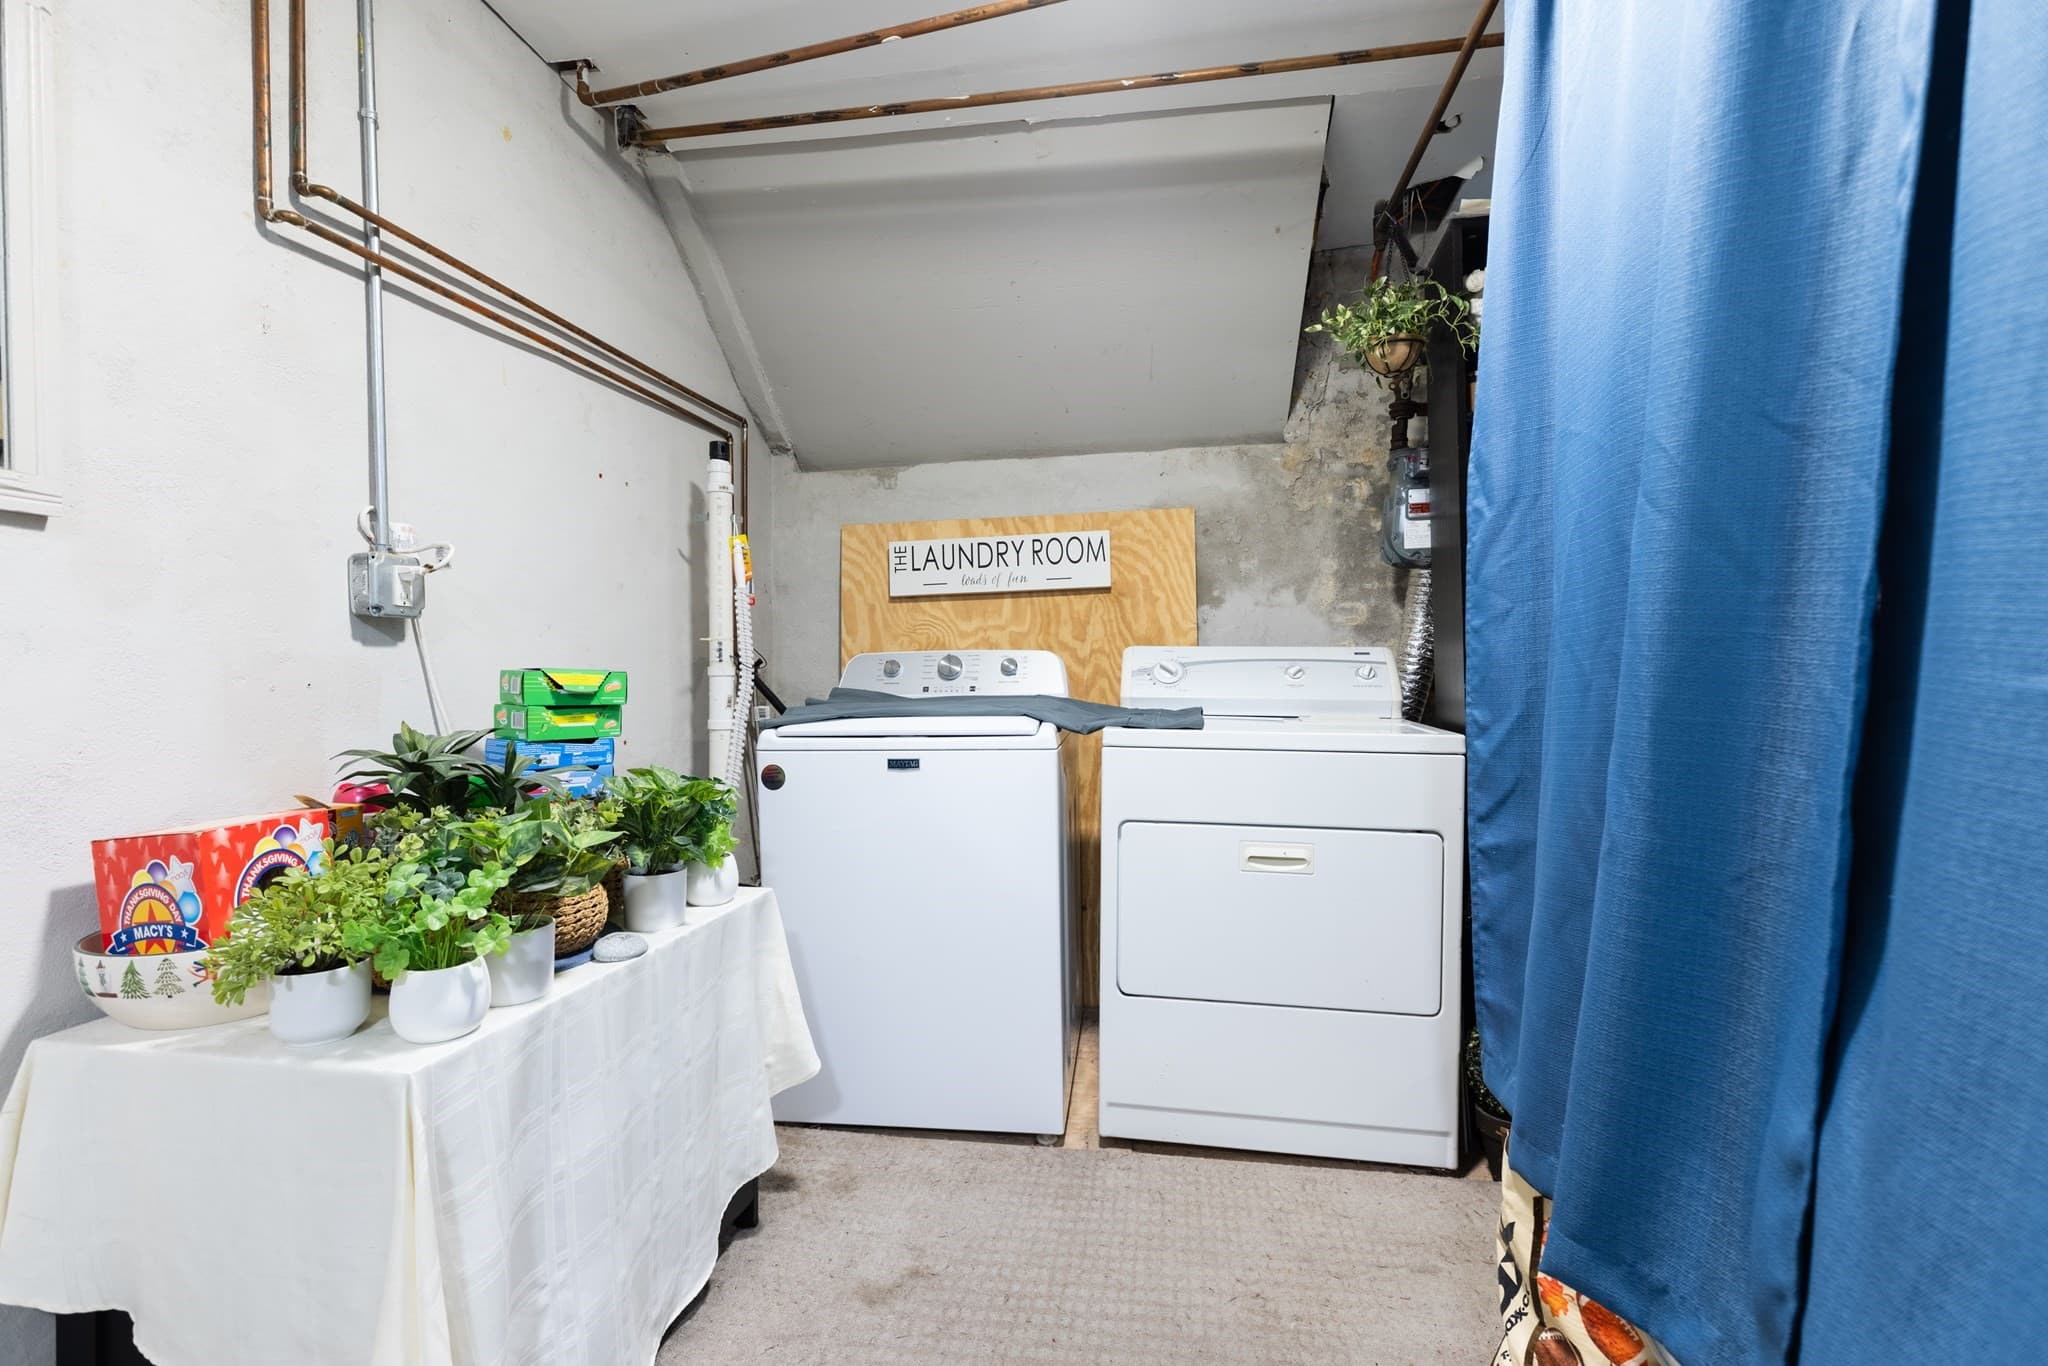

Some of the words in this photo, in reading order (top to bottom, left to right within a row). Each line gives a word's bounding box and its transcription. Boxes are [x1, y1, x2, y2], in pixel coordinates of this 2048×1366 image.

[894, 545, 908, 574] THE
[911, 540, 1025, 572] LAUNDRY
[1032, 536, 1107, 566] ROOM
[961, 573, 987, 587] loads
[991, 572, 1002, 588] of
[1007, 571, 1030, 588] fun
[888, 760, 919, 769] MAYTAG
[241, 853, 298, 898] THANKSGIVING
[124, 887, 169, 925] THANKSGIVING
[169, 903, 182, 923] DAY
[133, 924, 173, 941] MACY'S
